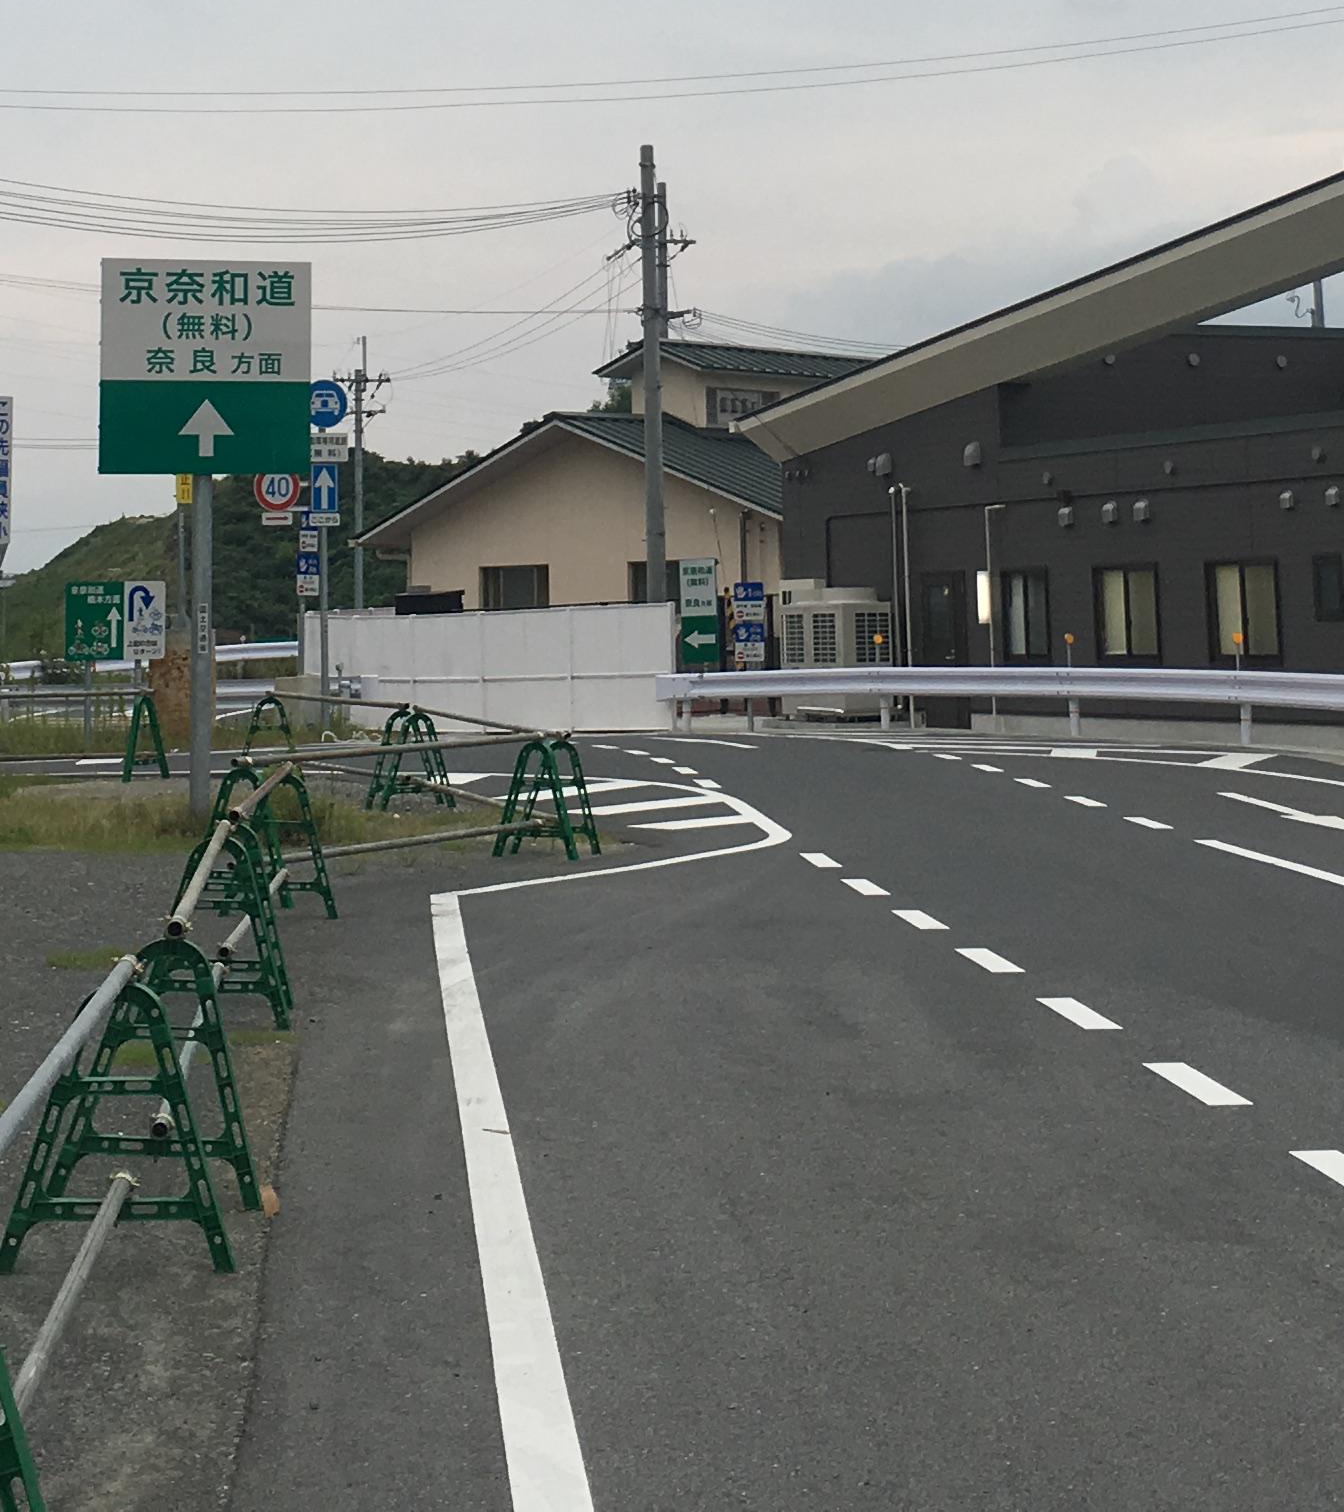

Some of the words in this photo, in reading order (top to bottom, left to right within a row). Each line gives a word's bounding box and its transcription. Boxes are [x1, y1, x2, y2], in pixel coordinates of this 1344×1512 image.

[119, 267, 296, 307] 京奈和道
[162, 311, 253, 341] (無料)
[265, 476, 291, 499] 40
